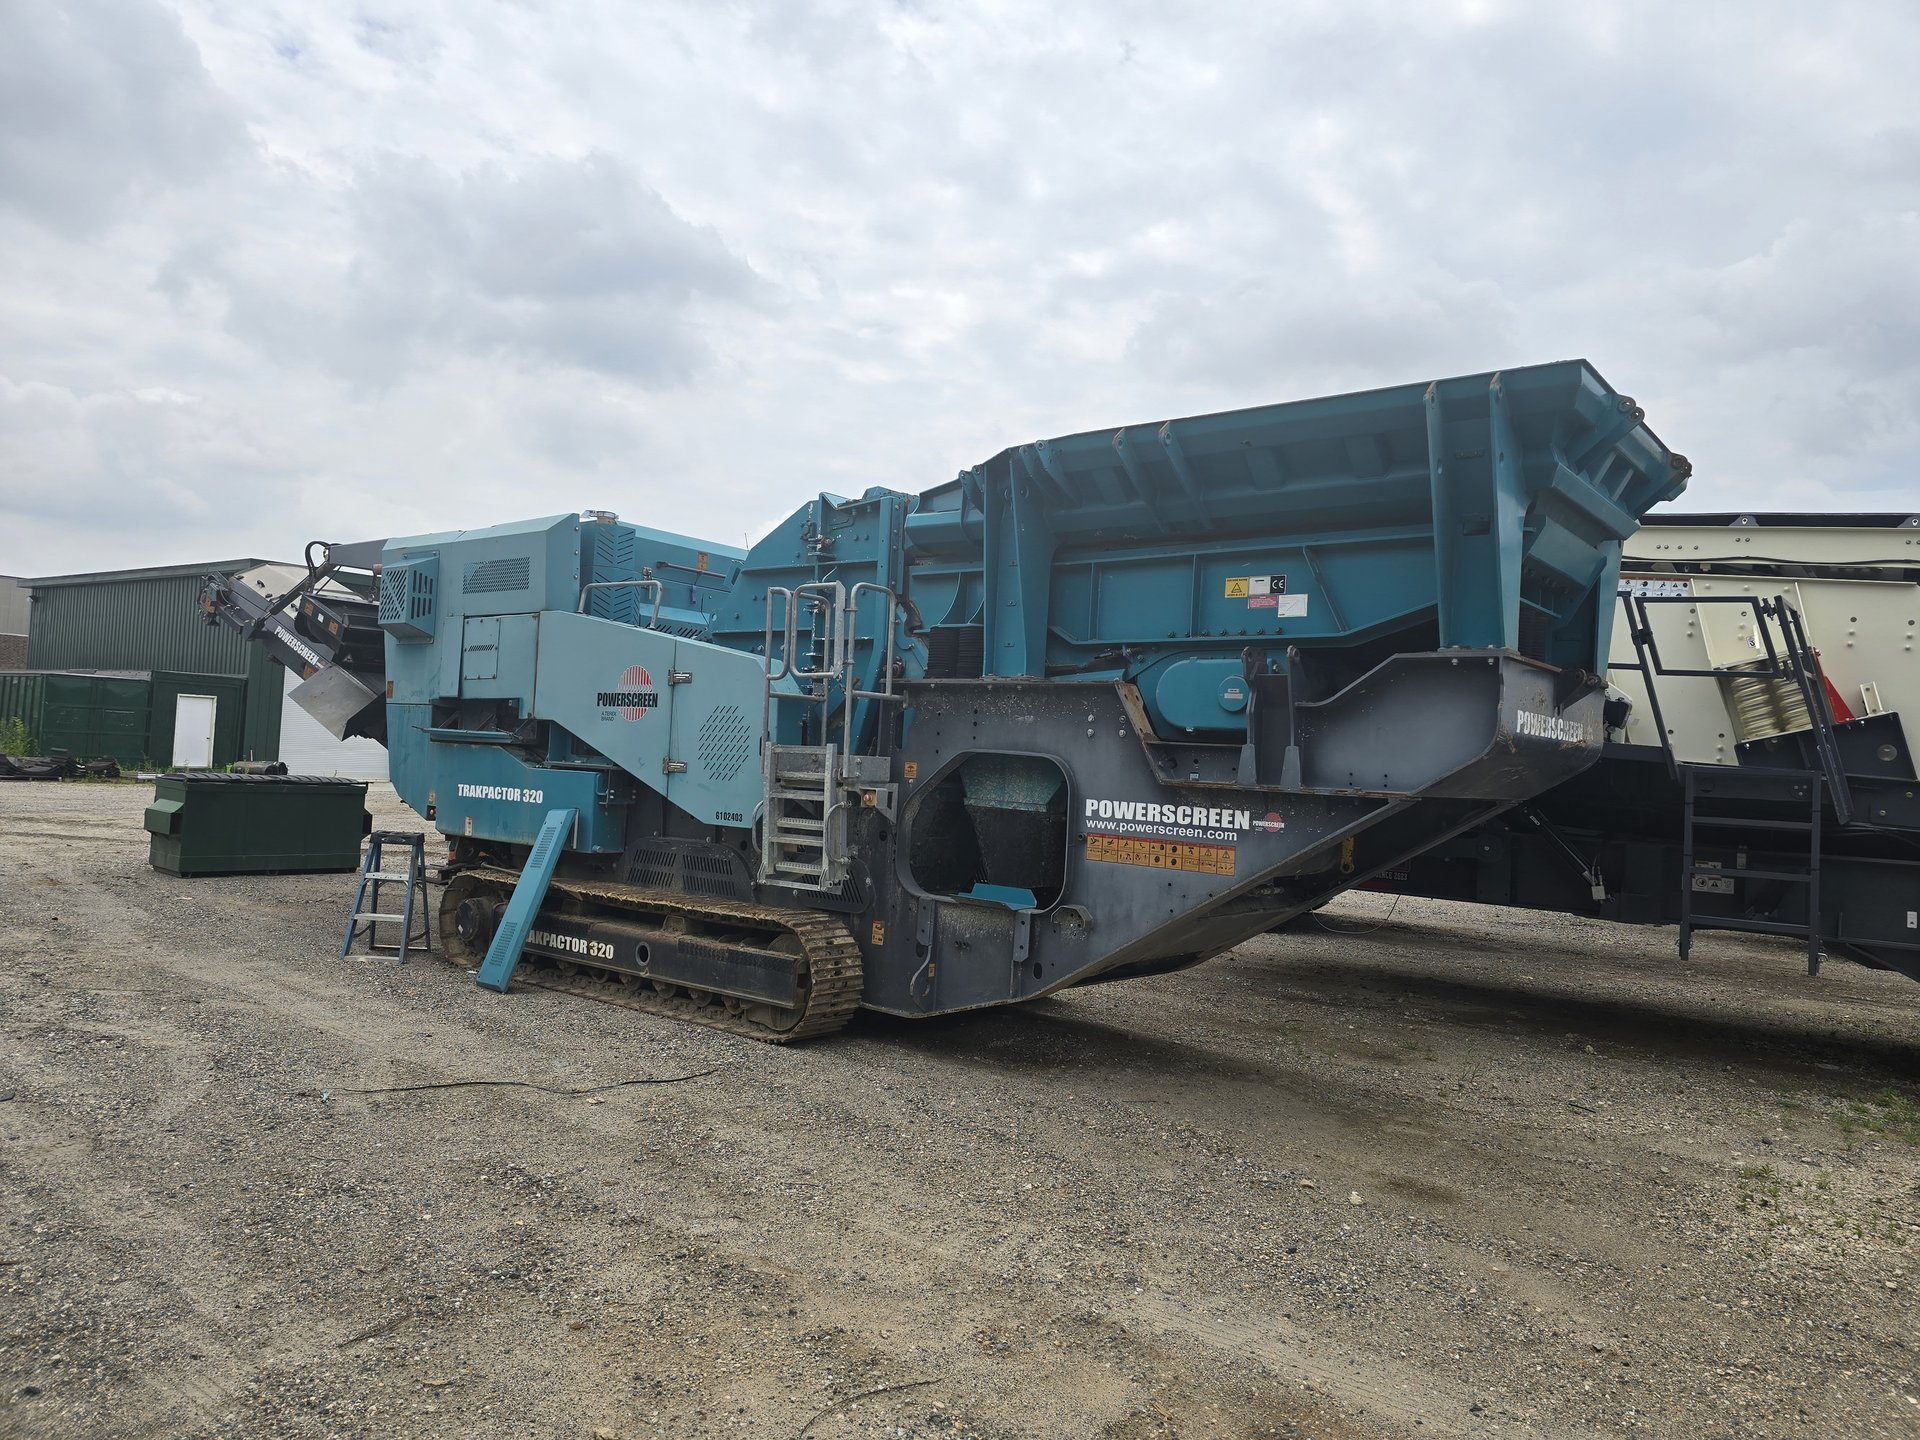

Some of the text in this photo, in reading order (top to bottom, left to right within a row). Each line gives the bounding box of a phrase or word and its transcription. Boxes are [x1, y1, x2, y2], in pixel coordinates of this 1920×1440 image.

[274, 625, 319, 666] POWERSCREEN
[596, 692, 658, 708] POWERSCREEN
[1516, 709, 1584, 743] POWERSCREEN
[457, 783, 544, 804] TRAKPACTOR 320
[715, 811, 743, 823] 6102403
[1085, 798, 1250, 830] POWERSCREEN
[1086, 819, 1238, 842] www.powerscreen.com
[526, 929, 614, 960] AKPACTOR 320
